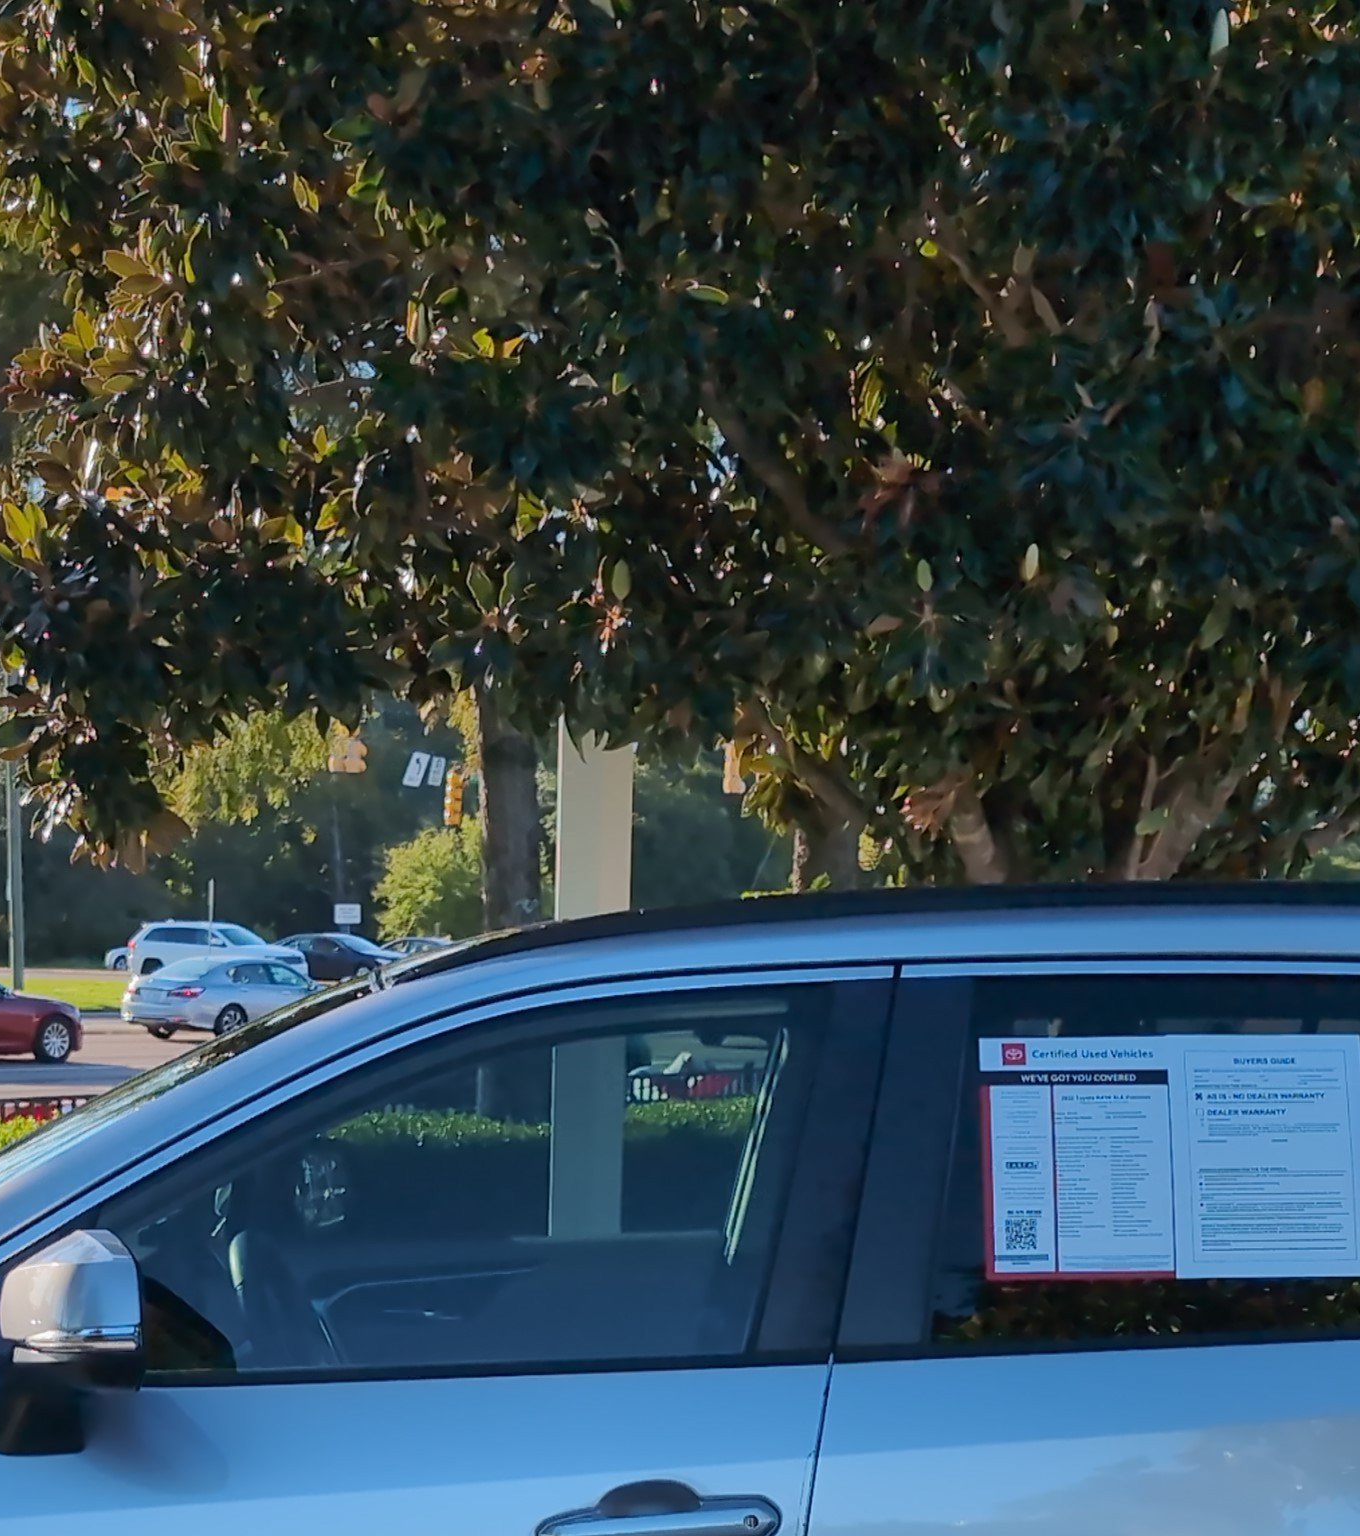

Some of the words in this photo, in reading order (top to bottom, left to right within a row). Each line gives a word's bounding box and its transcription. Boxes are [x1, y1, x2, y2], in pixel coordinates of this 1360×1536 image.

[1031, 1049, 1078, 1059] Certified
[1081, 1049, 1108, 1059] Used
[1109, 1048, 1154, 1058] Vehicles
[1233, 1057, 1268, 1065] BUYERS
[1270, 1057, 1297, 1065] GUIDE
[1020, 1073, 1049, 1083] WE'VE
[1050, 1073, 1070, 1083] GOT
[1071, 1073, 1092, 1082] YOU
[1093, 1073, 1137, 1082] COVERED
[1233, 1092, 1245, 1100] NO
[1246, 1092, 1279, 1100] DEALER
[1280, 1092, 1325, 1100] WARRANTY
[1207, 1108, 1240, 1116] DEALER
[1241, 1108, 1287, 1116] WARRANTY
